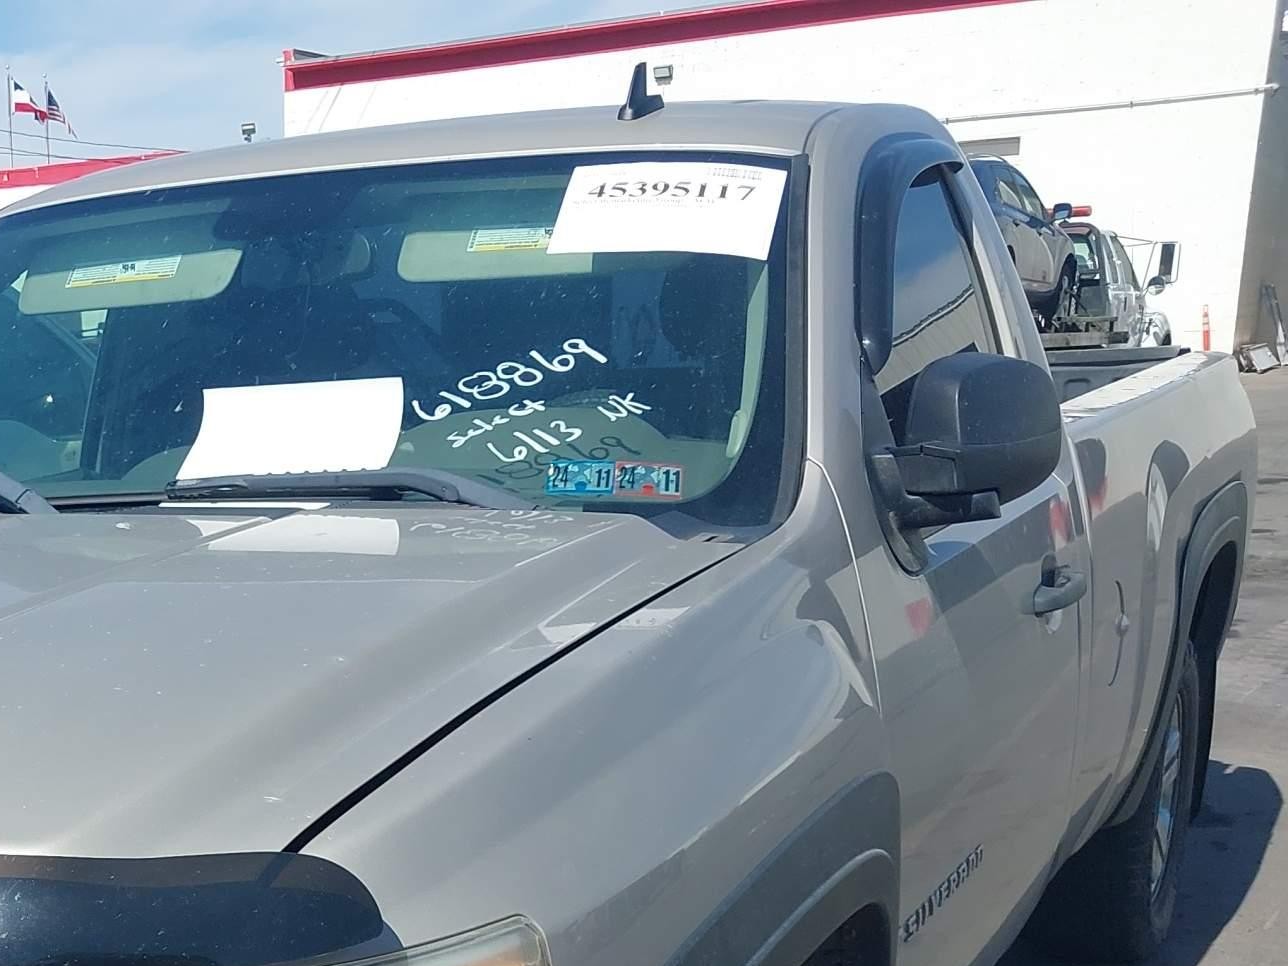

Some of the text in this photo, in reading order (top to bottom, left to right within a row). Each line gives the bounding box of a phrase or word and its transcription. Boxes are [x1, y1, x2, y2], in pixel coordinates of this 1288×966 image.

[587, 180, 757, 201] 45395117
[411, 337, 609, 422] 618869
[487, 419, 583, 463] 6113
[551, 464, 570, 489] 24
[618, 465, 636, 490] 24
